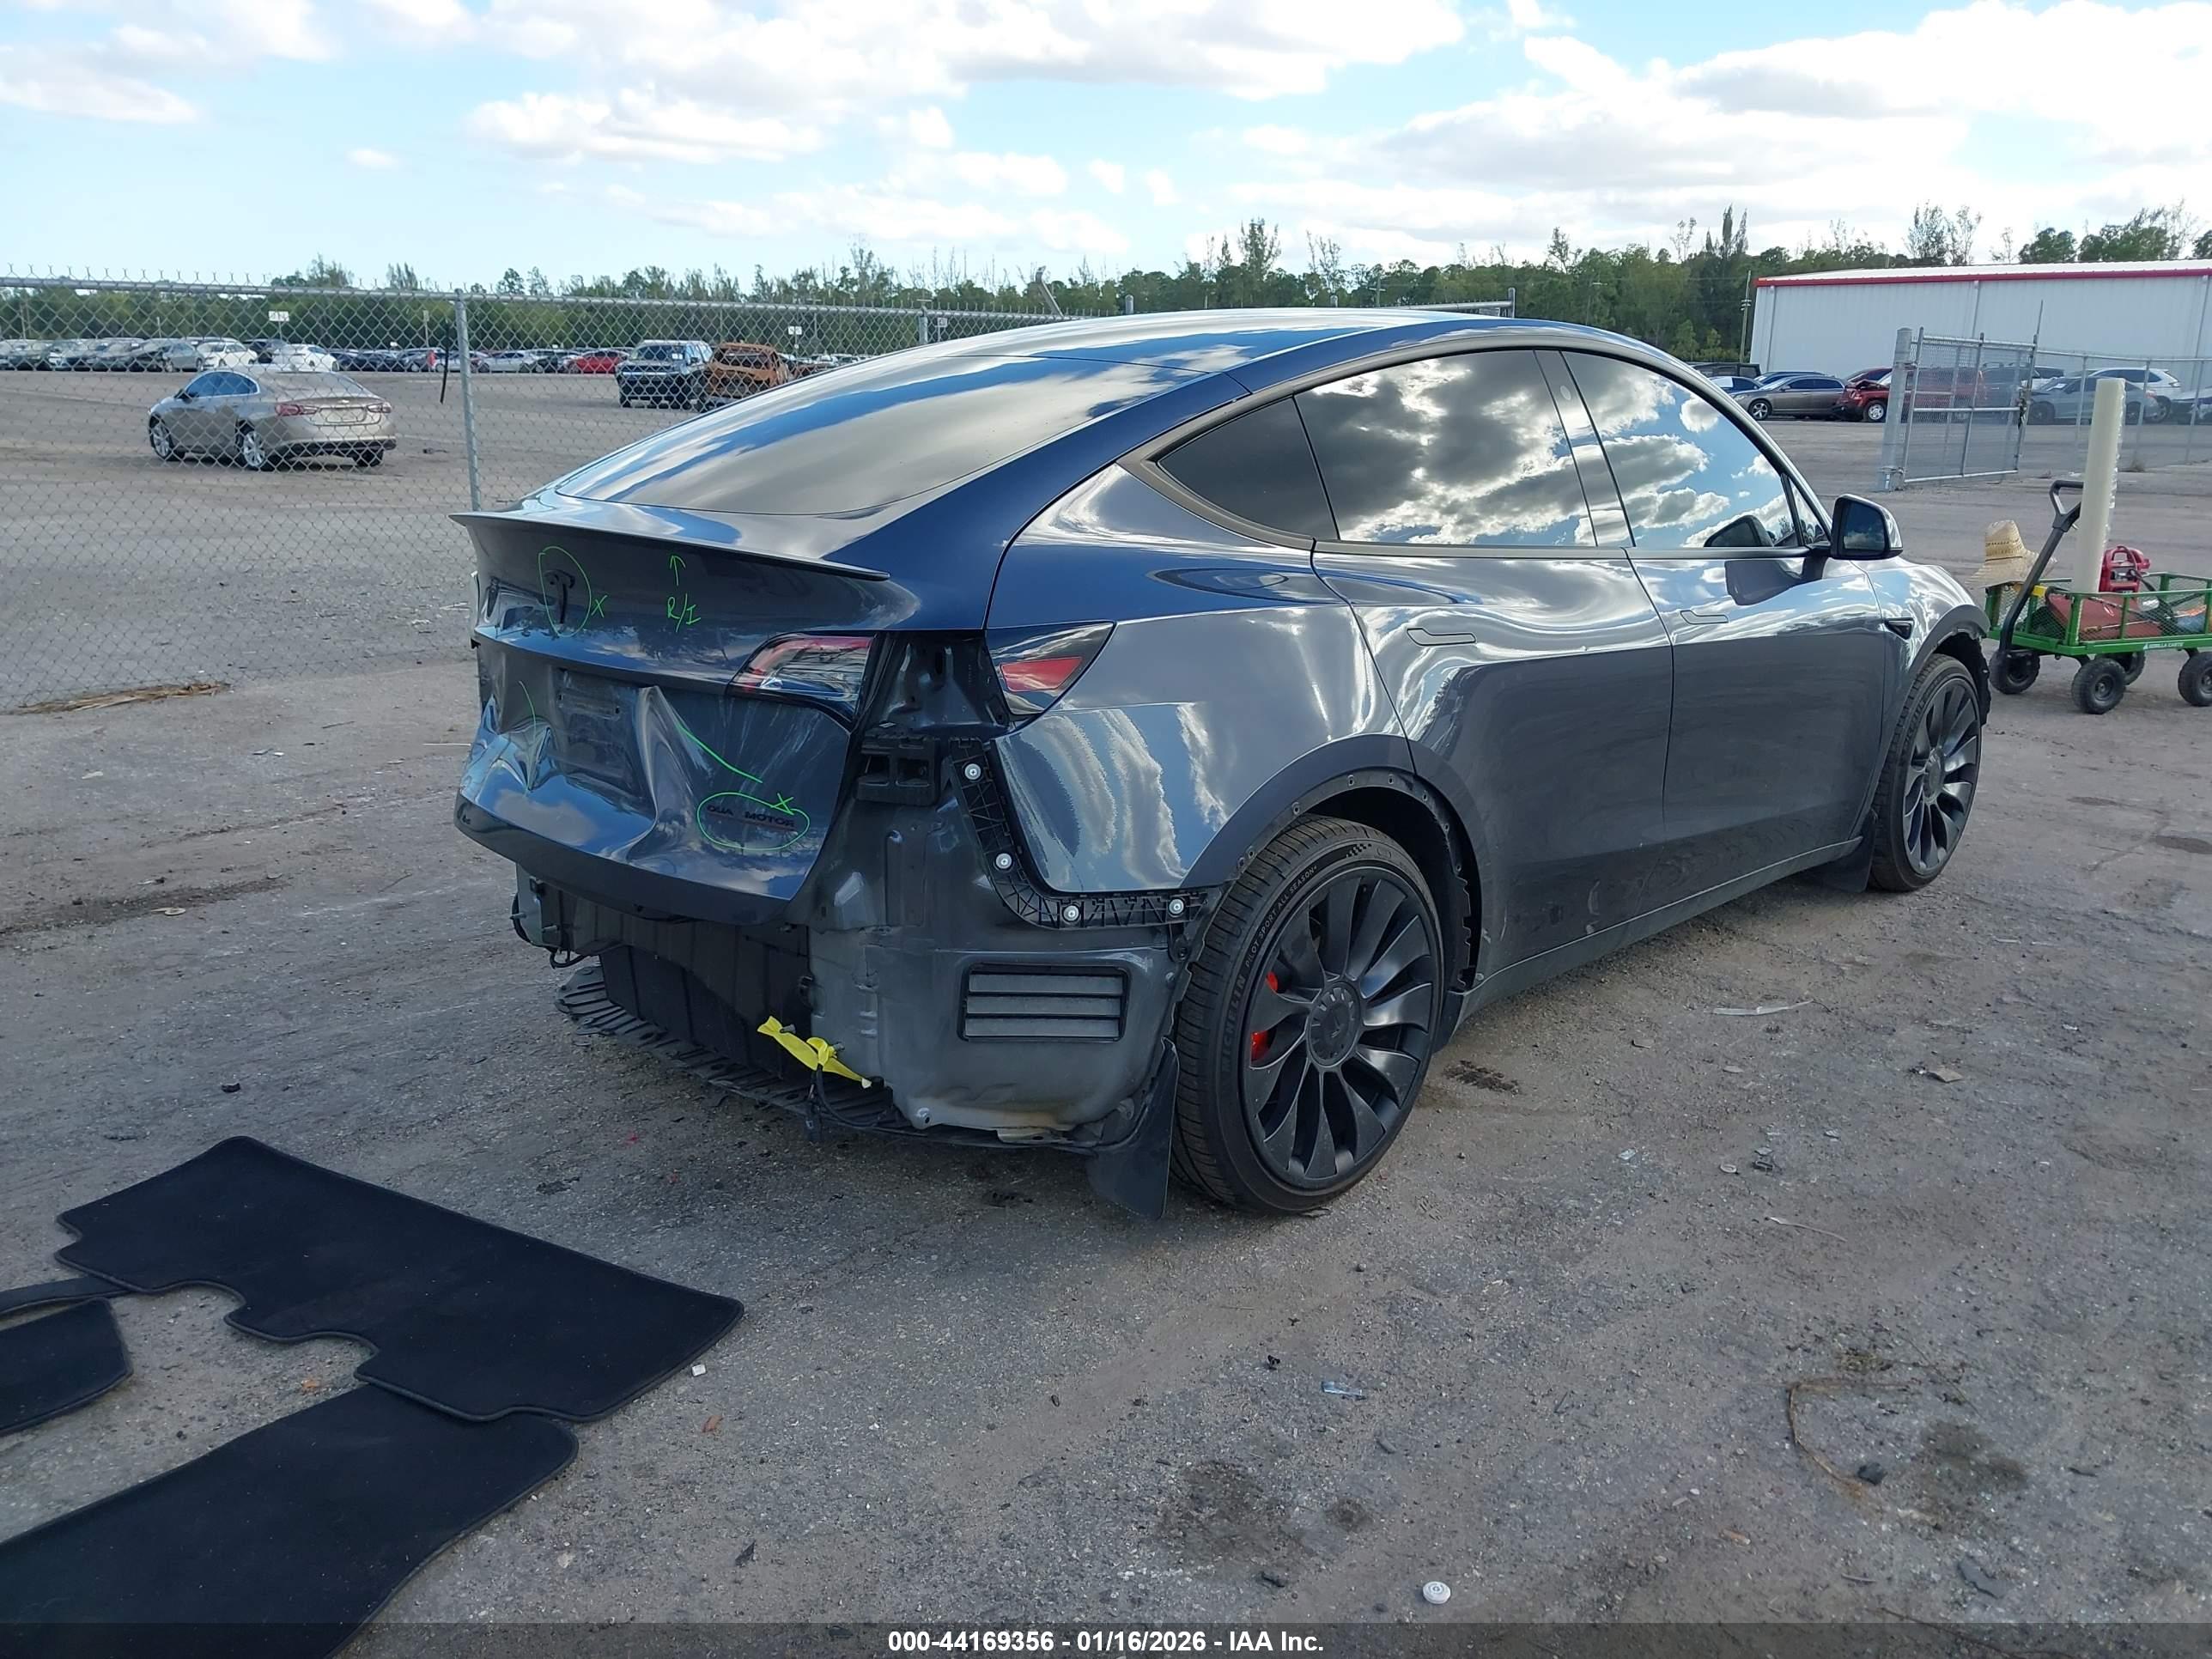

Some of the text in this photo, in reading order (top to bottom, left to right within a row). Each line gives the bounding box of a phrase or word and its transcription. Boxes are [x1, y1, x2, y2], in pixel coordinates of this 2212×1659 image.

[744, 811, 796, 827] MOTOR
[1221, 974, 1246, 1073] MICHELIN
[1244, 939, 1261, 969] PILOT
[1258, 909, 1279, 939] SPORT
[1276, 896, 1290, 911] ALL
